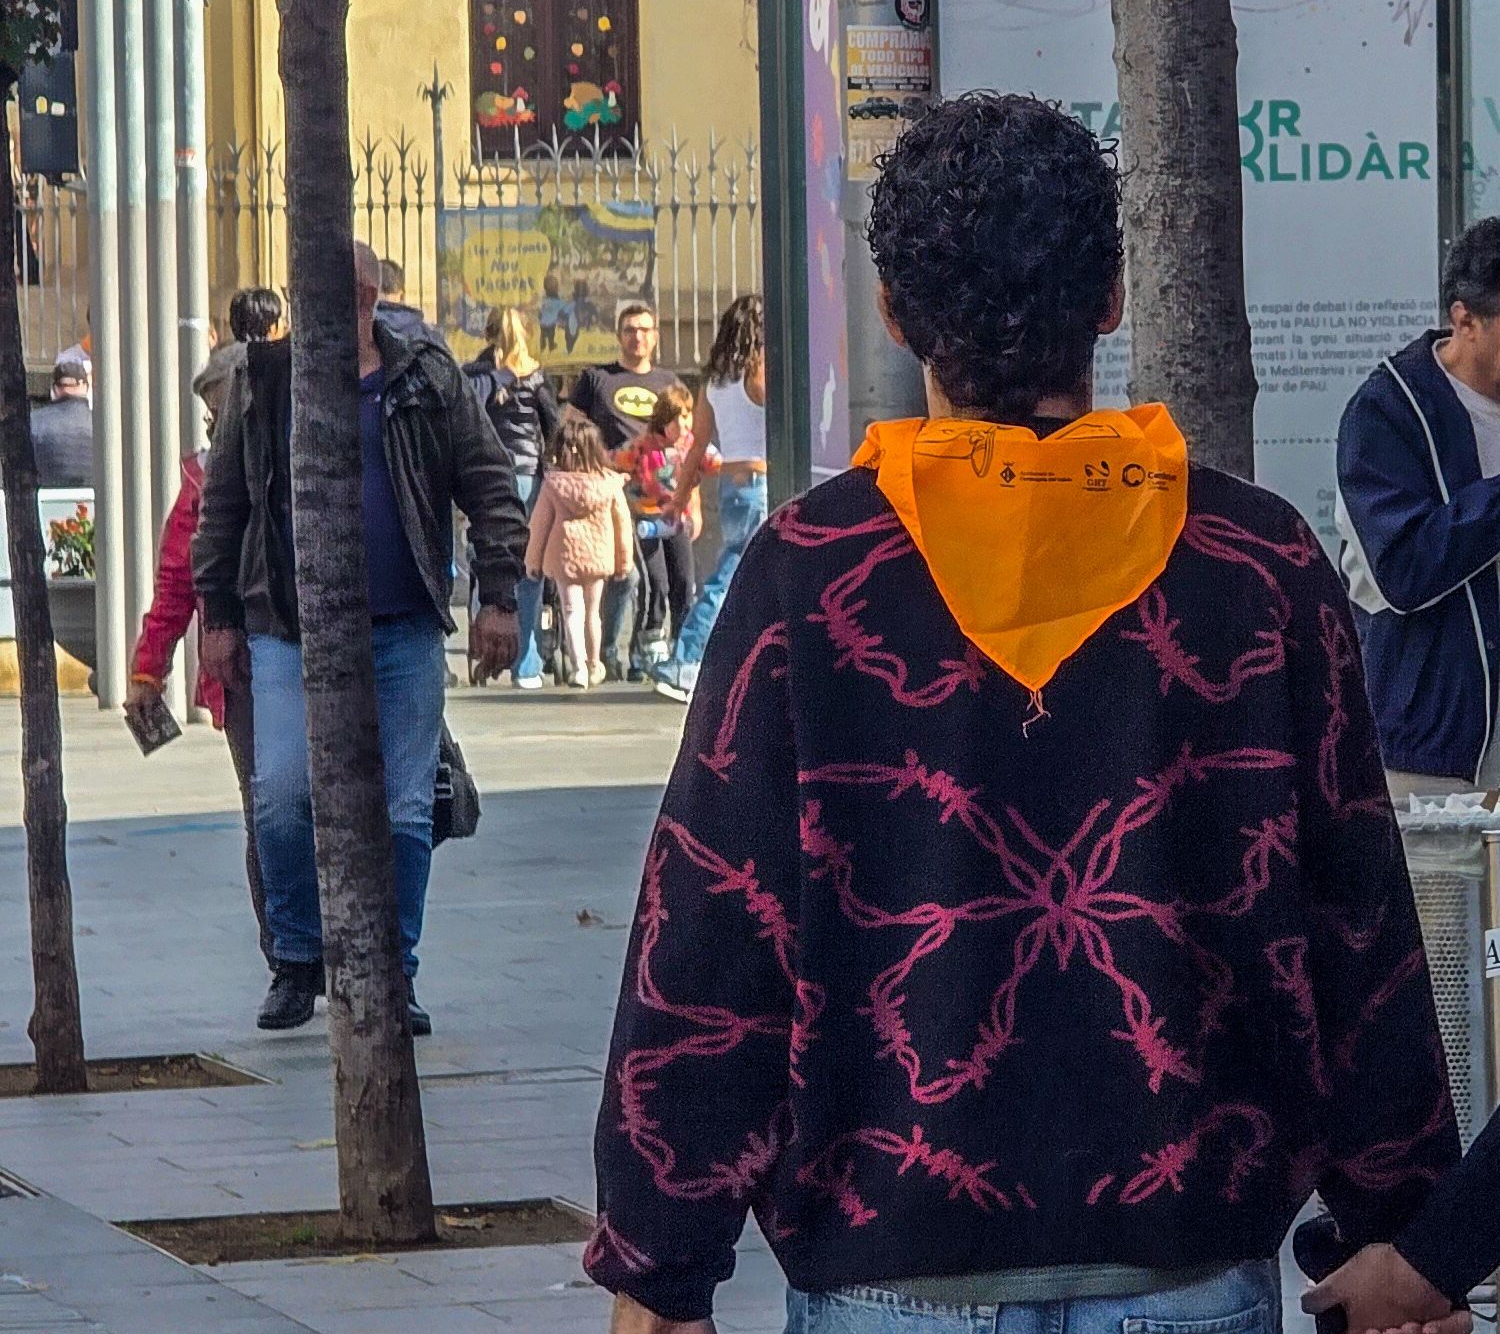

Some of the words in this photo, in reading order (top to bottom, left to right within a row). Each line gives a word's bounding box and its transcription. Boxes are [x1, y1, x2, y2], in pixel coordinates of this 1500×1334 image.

[1262, 301, 1293, 317] espai
[1296, 300, 1310, 313] de
[1313, 300, 1346, 313] debat
[1355, 300, 1371, 313] de
[1251, 316, 1278, 329] obre
[1281, 316, 1292, 329] la
[1294, 316, 1319, 329] PAU
[1330, 316, 1345, 328] LA
[1349, 315, 1368, 328] NO
[1253, 333, 1285, 345] avant
[1292, 332, 1303, 345] la
[1310, 334, 1338, 349] greu
[1345, 332, 1392, 345] situació
[1297, 349, 1308, 362] la
[1283, 380, 1297, 393] de
